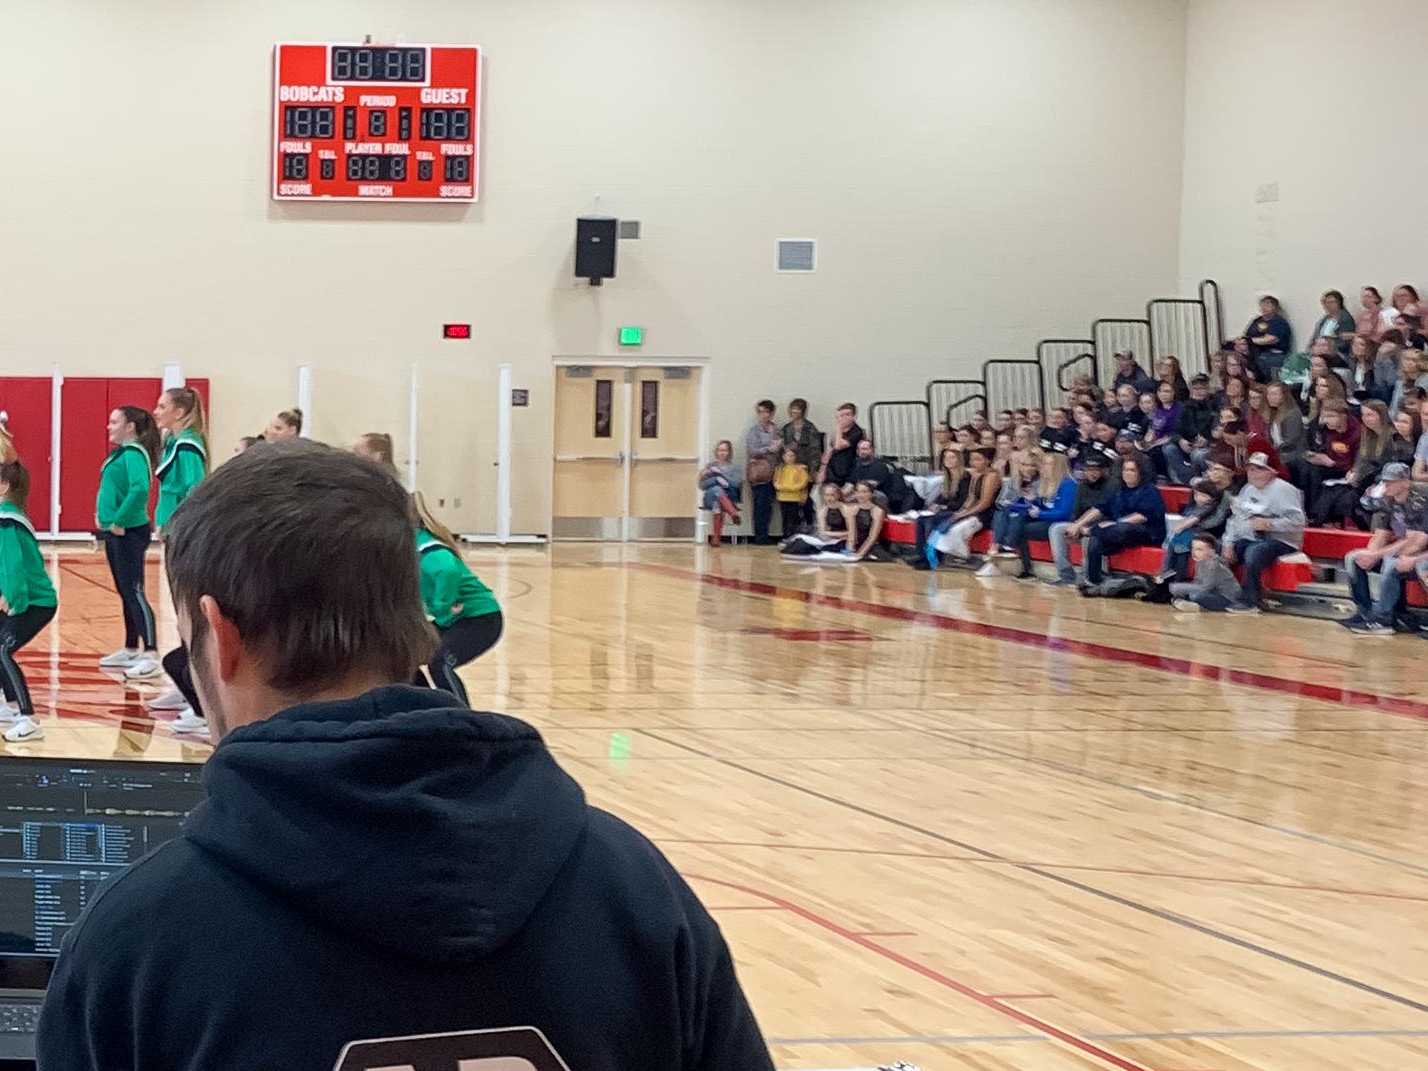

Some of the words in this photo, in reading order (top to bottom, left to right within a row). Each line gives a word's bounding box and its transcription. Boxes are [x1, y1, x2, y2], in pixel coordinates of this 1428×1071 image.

[280, 86, 344, 102] BOBCATS
[420, 88, 469, 104] GUEST
[359, 95, 397, 106] PERIOD
[279, 142, 312, 153] FOULS
[344, 142, 383, 154] PLAYER
[385, 143, 410, 154] FOUL
[440, 144, 473, 155] FOULS
[279, 184, 312, 195] SCORE
[439, 185, 472, 197] SCORE
